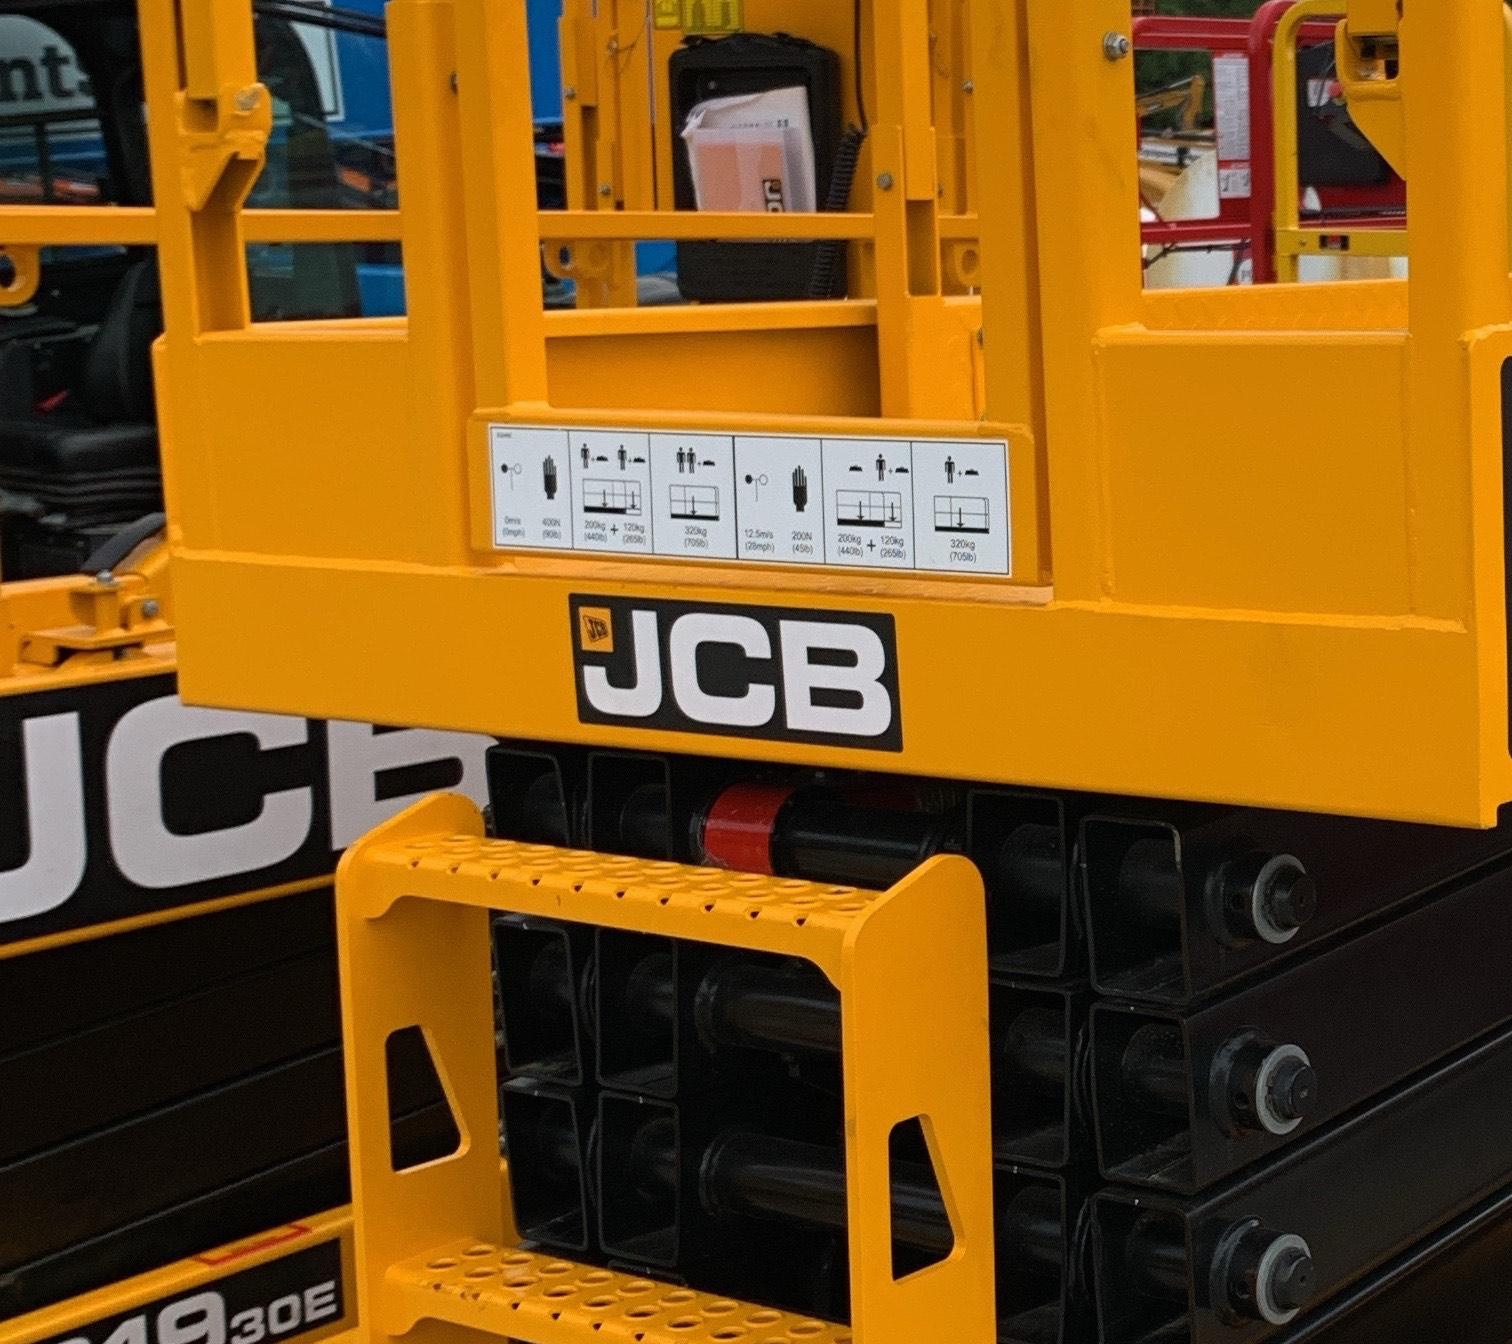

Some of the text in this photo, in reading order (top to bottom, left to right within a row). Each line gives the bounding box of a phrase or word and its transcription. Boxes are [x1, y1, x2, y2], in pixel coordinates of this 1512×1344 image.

[838, 533, 904, 548] 200kg 120kg
[951, 538, 975, 551] 320kg
[950, 550, 977, 563] (705lb)
[583, 609, 892, 737] JCB
